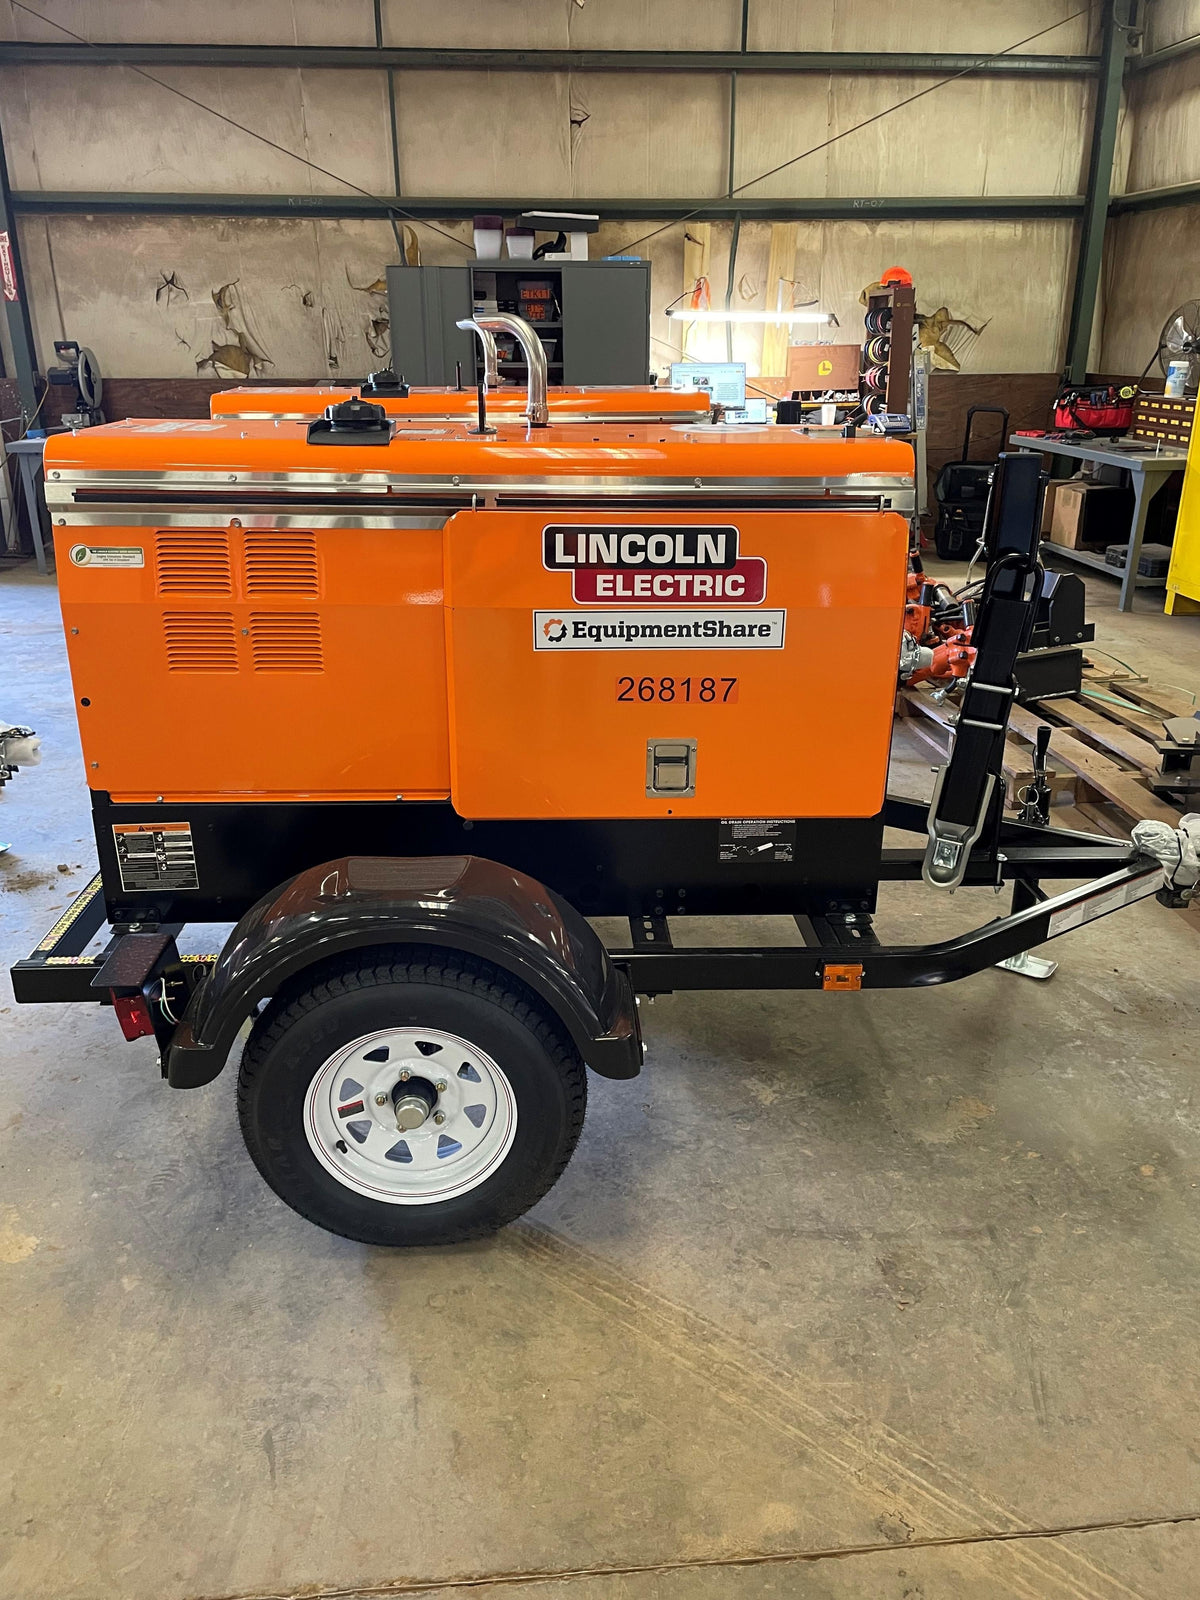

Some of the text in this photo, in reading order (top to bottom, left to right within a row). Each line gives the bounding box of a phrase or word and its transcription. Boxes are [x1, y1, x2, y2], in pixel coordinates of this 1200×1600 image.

[555, 533, 726, 564] LINCOLN
[596, 574, 746, 597] ELECTRIC
[572, 620, 771, 642] EquipmentShare
[617, 676, 738, 703] 268187
